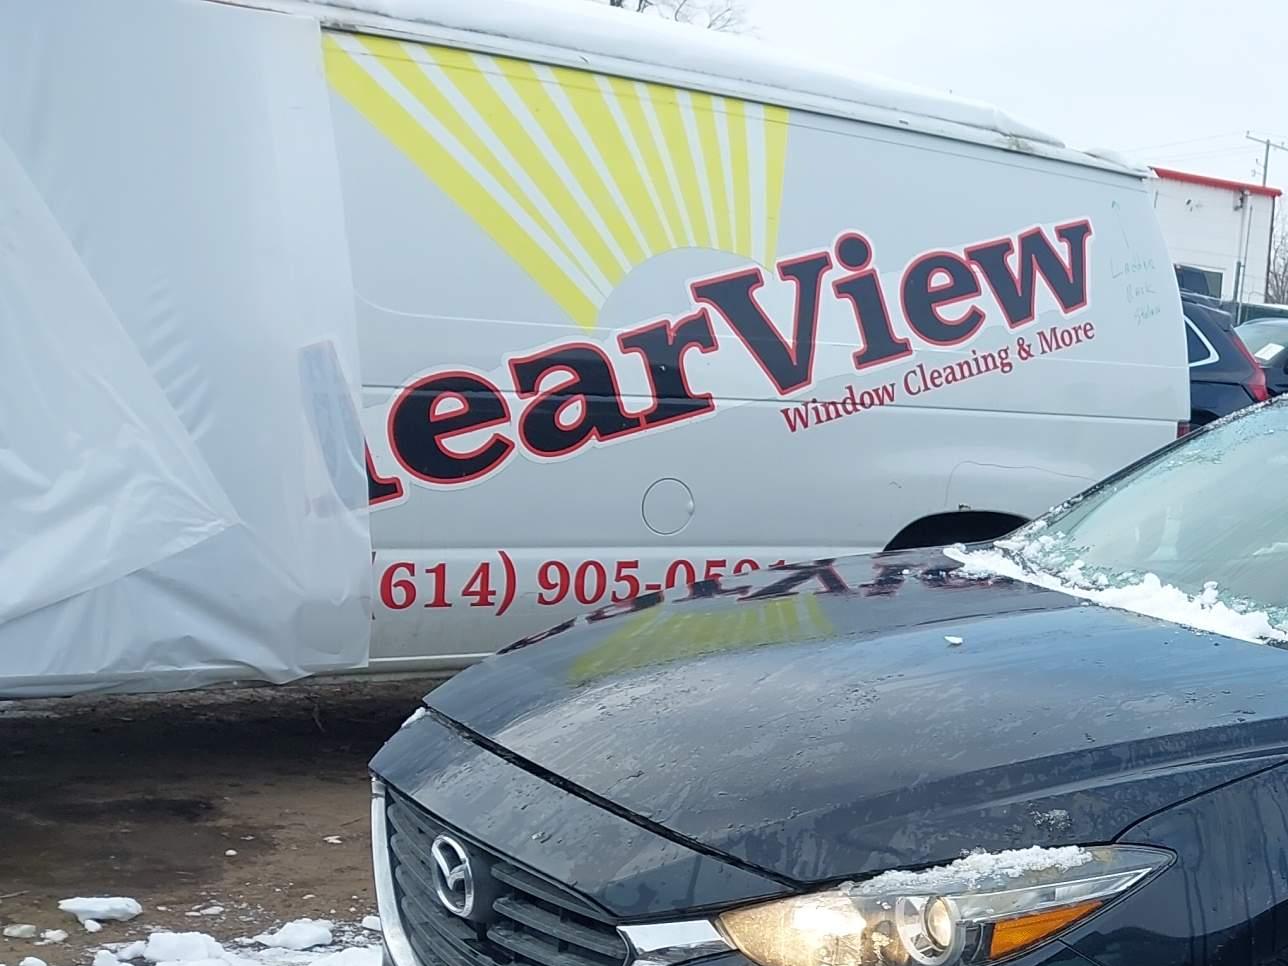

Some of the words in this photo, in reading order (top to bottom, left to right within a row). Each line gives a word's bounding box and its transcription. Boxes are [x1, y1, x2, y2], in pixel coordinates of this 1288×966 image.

[780, 383, 896, 432] Window
[903, 347, 1013, 397] Cleaning
[1016, 336, 1034, 360] &
[1036, 322, 1095, 354] More
[372, 550, 516, 617] 614)
